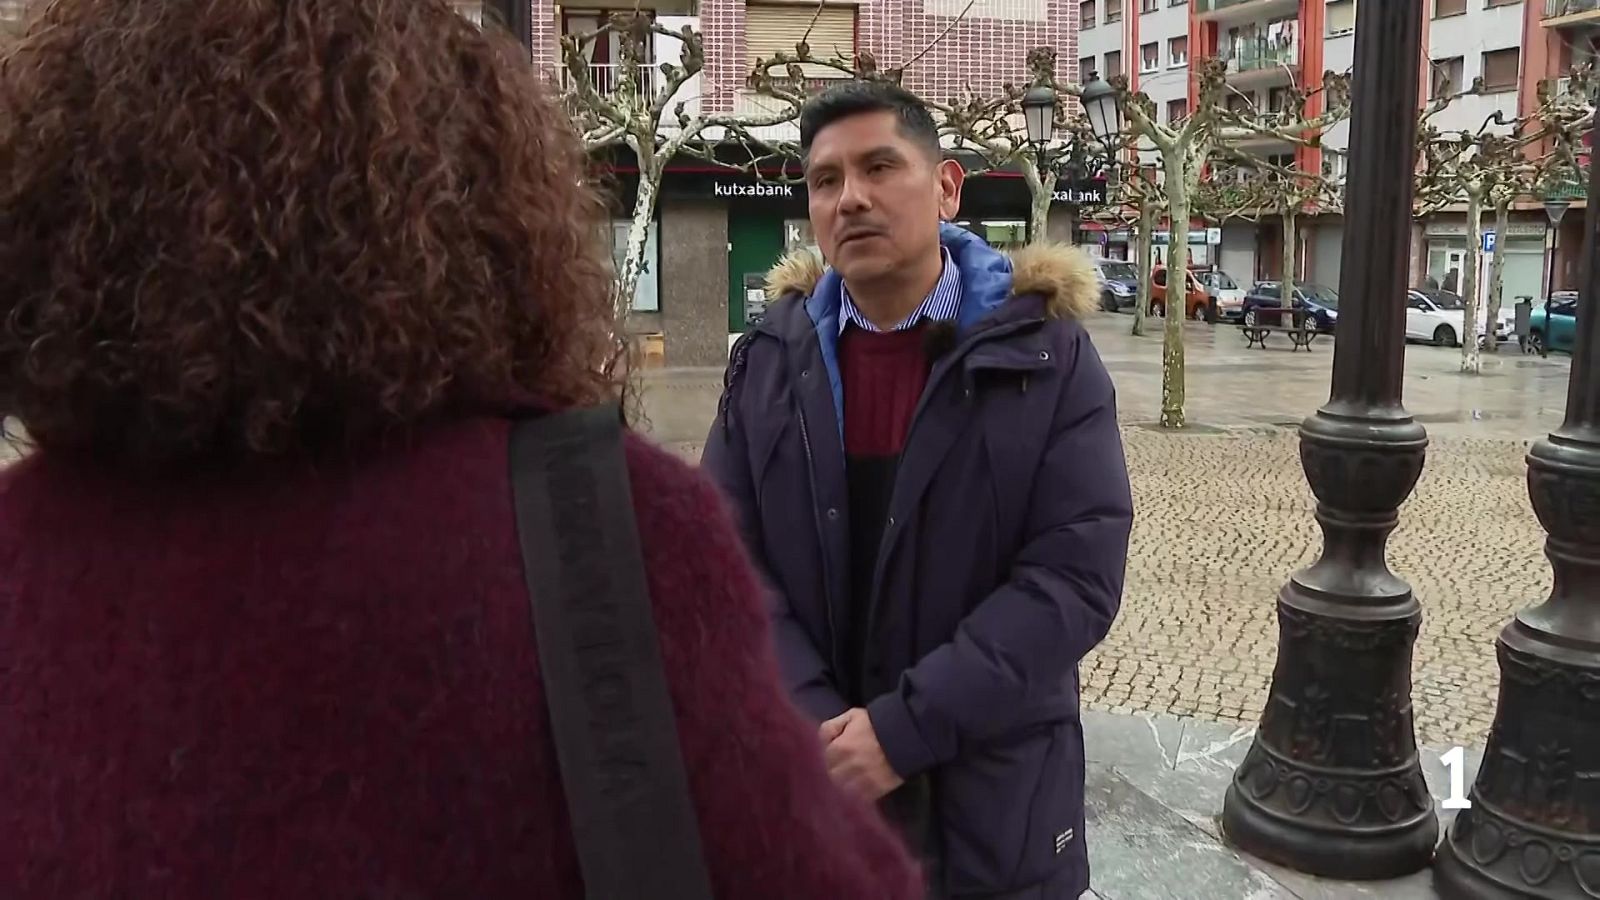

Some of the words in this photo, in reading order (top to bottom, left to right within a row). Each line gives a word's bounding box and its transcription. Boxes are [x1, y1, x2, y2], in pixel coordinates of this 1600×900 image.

[714, 181, 793, 197] kutxabank
[788, 224, 801, 242] k
[1486, 233, 1496, 250] P
